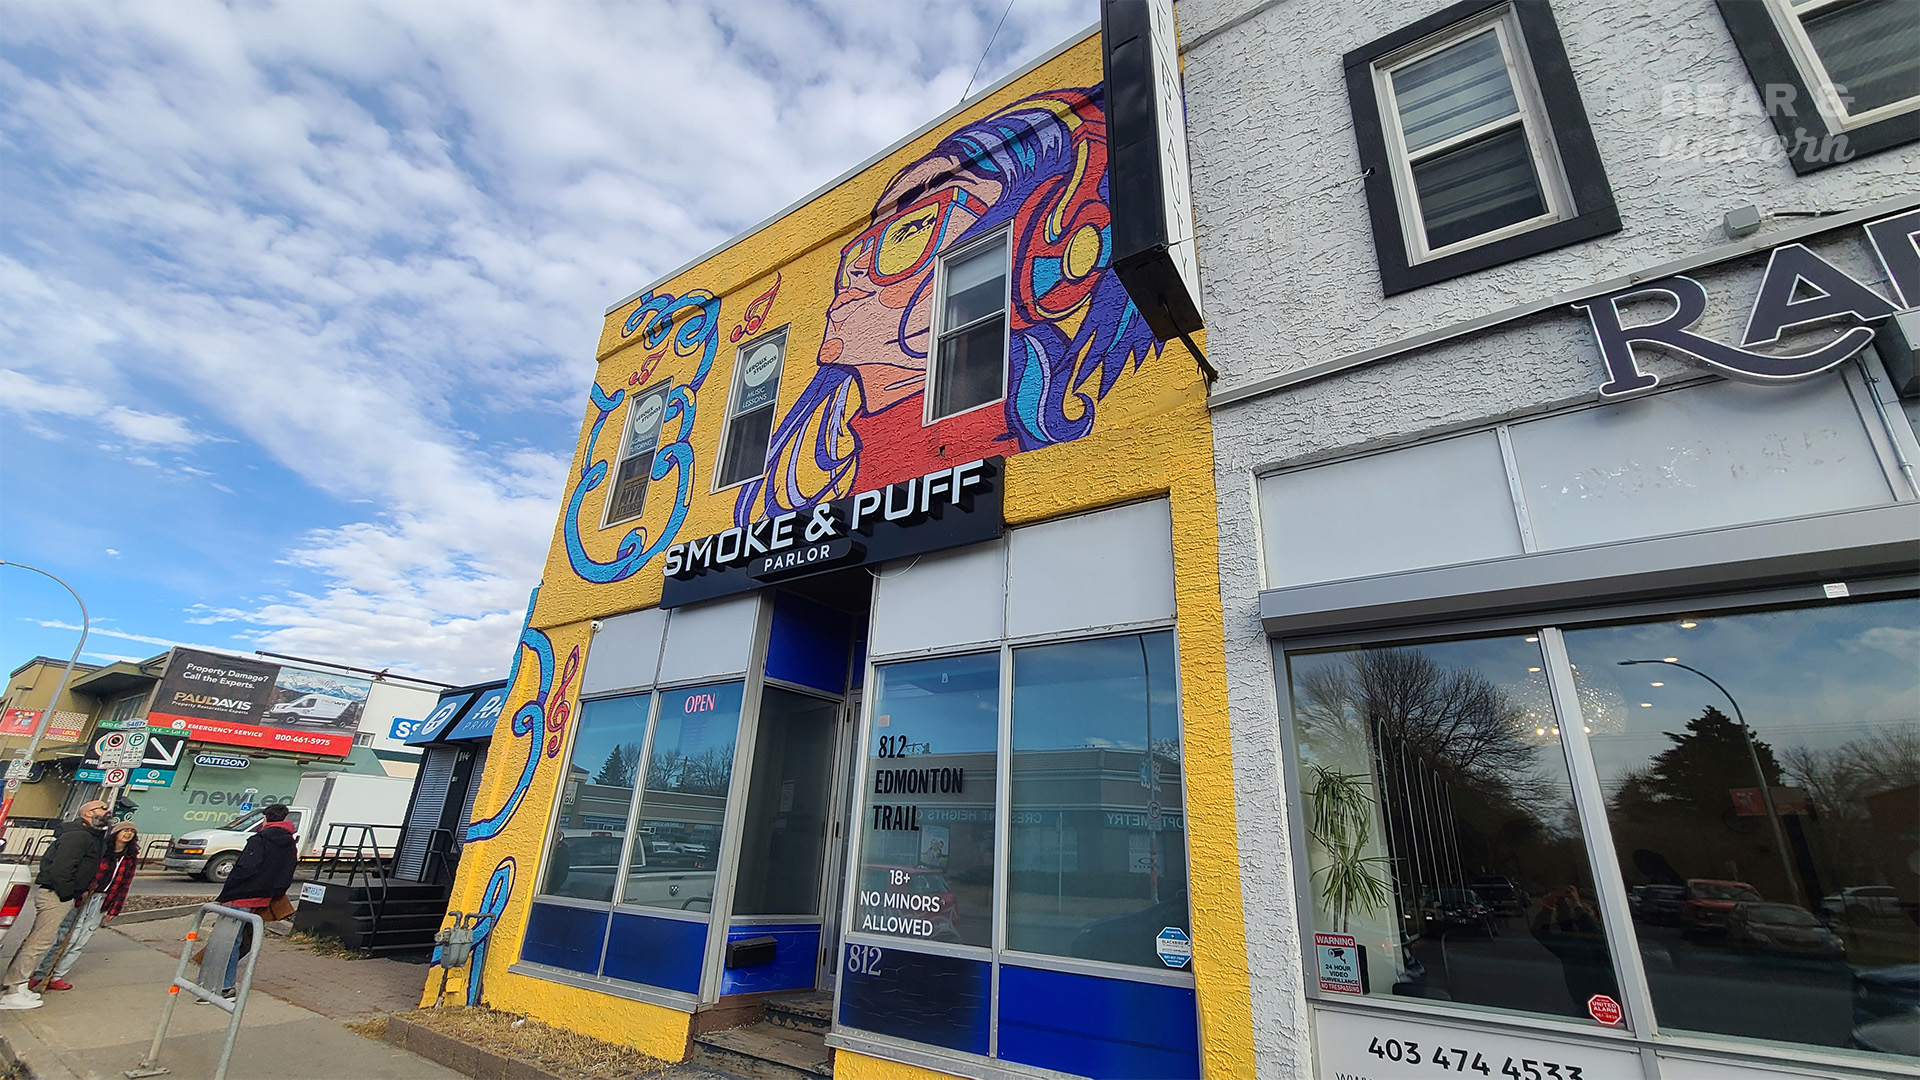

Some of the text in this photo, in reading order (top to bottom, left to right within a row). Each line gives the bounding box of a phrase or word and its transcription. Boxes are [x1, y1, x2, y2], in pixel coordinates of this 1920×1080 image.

[1571, 208, 1920, 397] RA
[746, 355, 767, 375] LEROUX
[752, 354, 777, 375] STUDIOS
[742, 393, 768, 409] LESSONS
[747, 385, 766, 399] MUSIC
[662, 459, 984, 577] SMOKE & PUFF
[763, 545, 831, 572] PARLOR
[183, 671, 255, 689] Call the Experts.
[186, 662, 269, 682] Property Damage?
[171, 701, 249, 715] Property Restoration Experts
[685, 693, 716, 714] OPEN
[187, 723, 263, 738] EMERGENCY SERVICE
[275, 733, 331, 746] 800-661-5975
[878, 735, 907, 758] 812
[198, 756, 246, 767] PATTISON
[874, 768, 964, 794] EDMONTON
[873, 805, 920, 831] TRAIL
[889, 869, 911, 886] 18+
[860, 890, 941, 912] NO MINORS
[862, 914, 934, 937] ALLOWED
[1315, 935, 1354, 946] WARNING
[848, 945, 883, 977] 812
[1321, 976, 1359, 985] SURVEILLANCE
[1329, 984, 1360, 992] TRESPASSING
[1592, 1001, 1617, 1009] UNITED
[1594, 1006, 1617, 1014] ALARM
[1368, 1036, 1584, 1080] 403 474 4533
